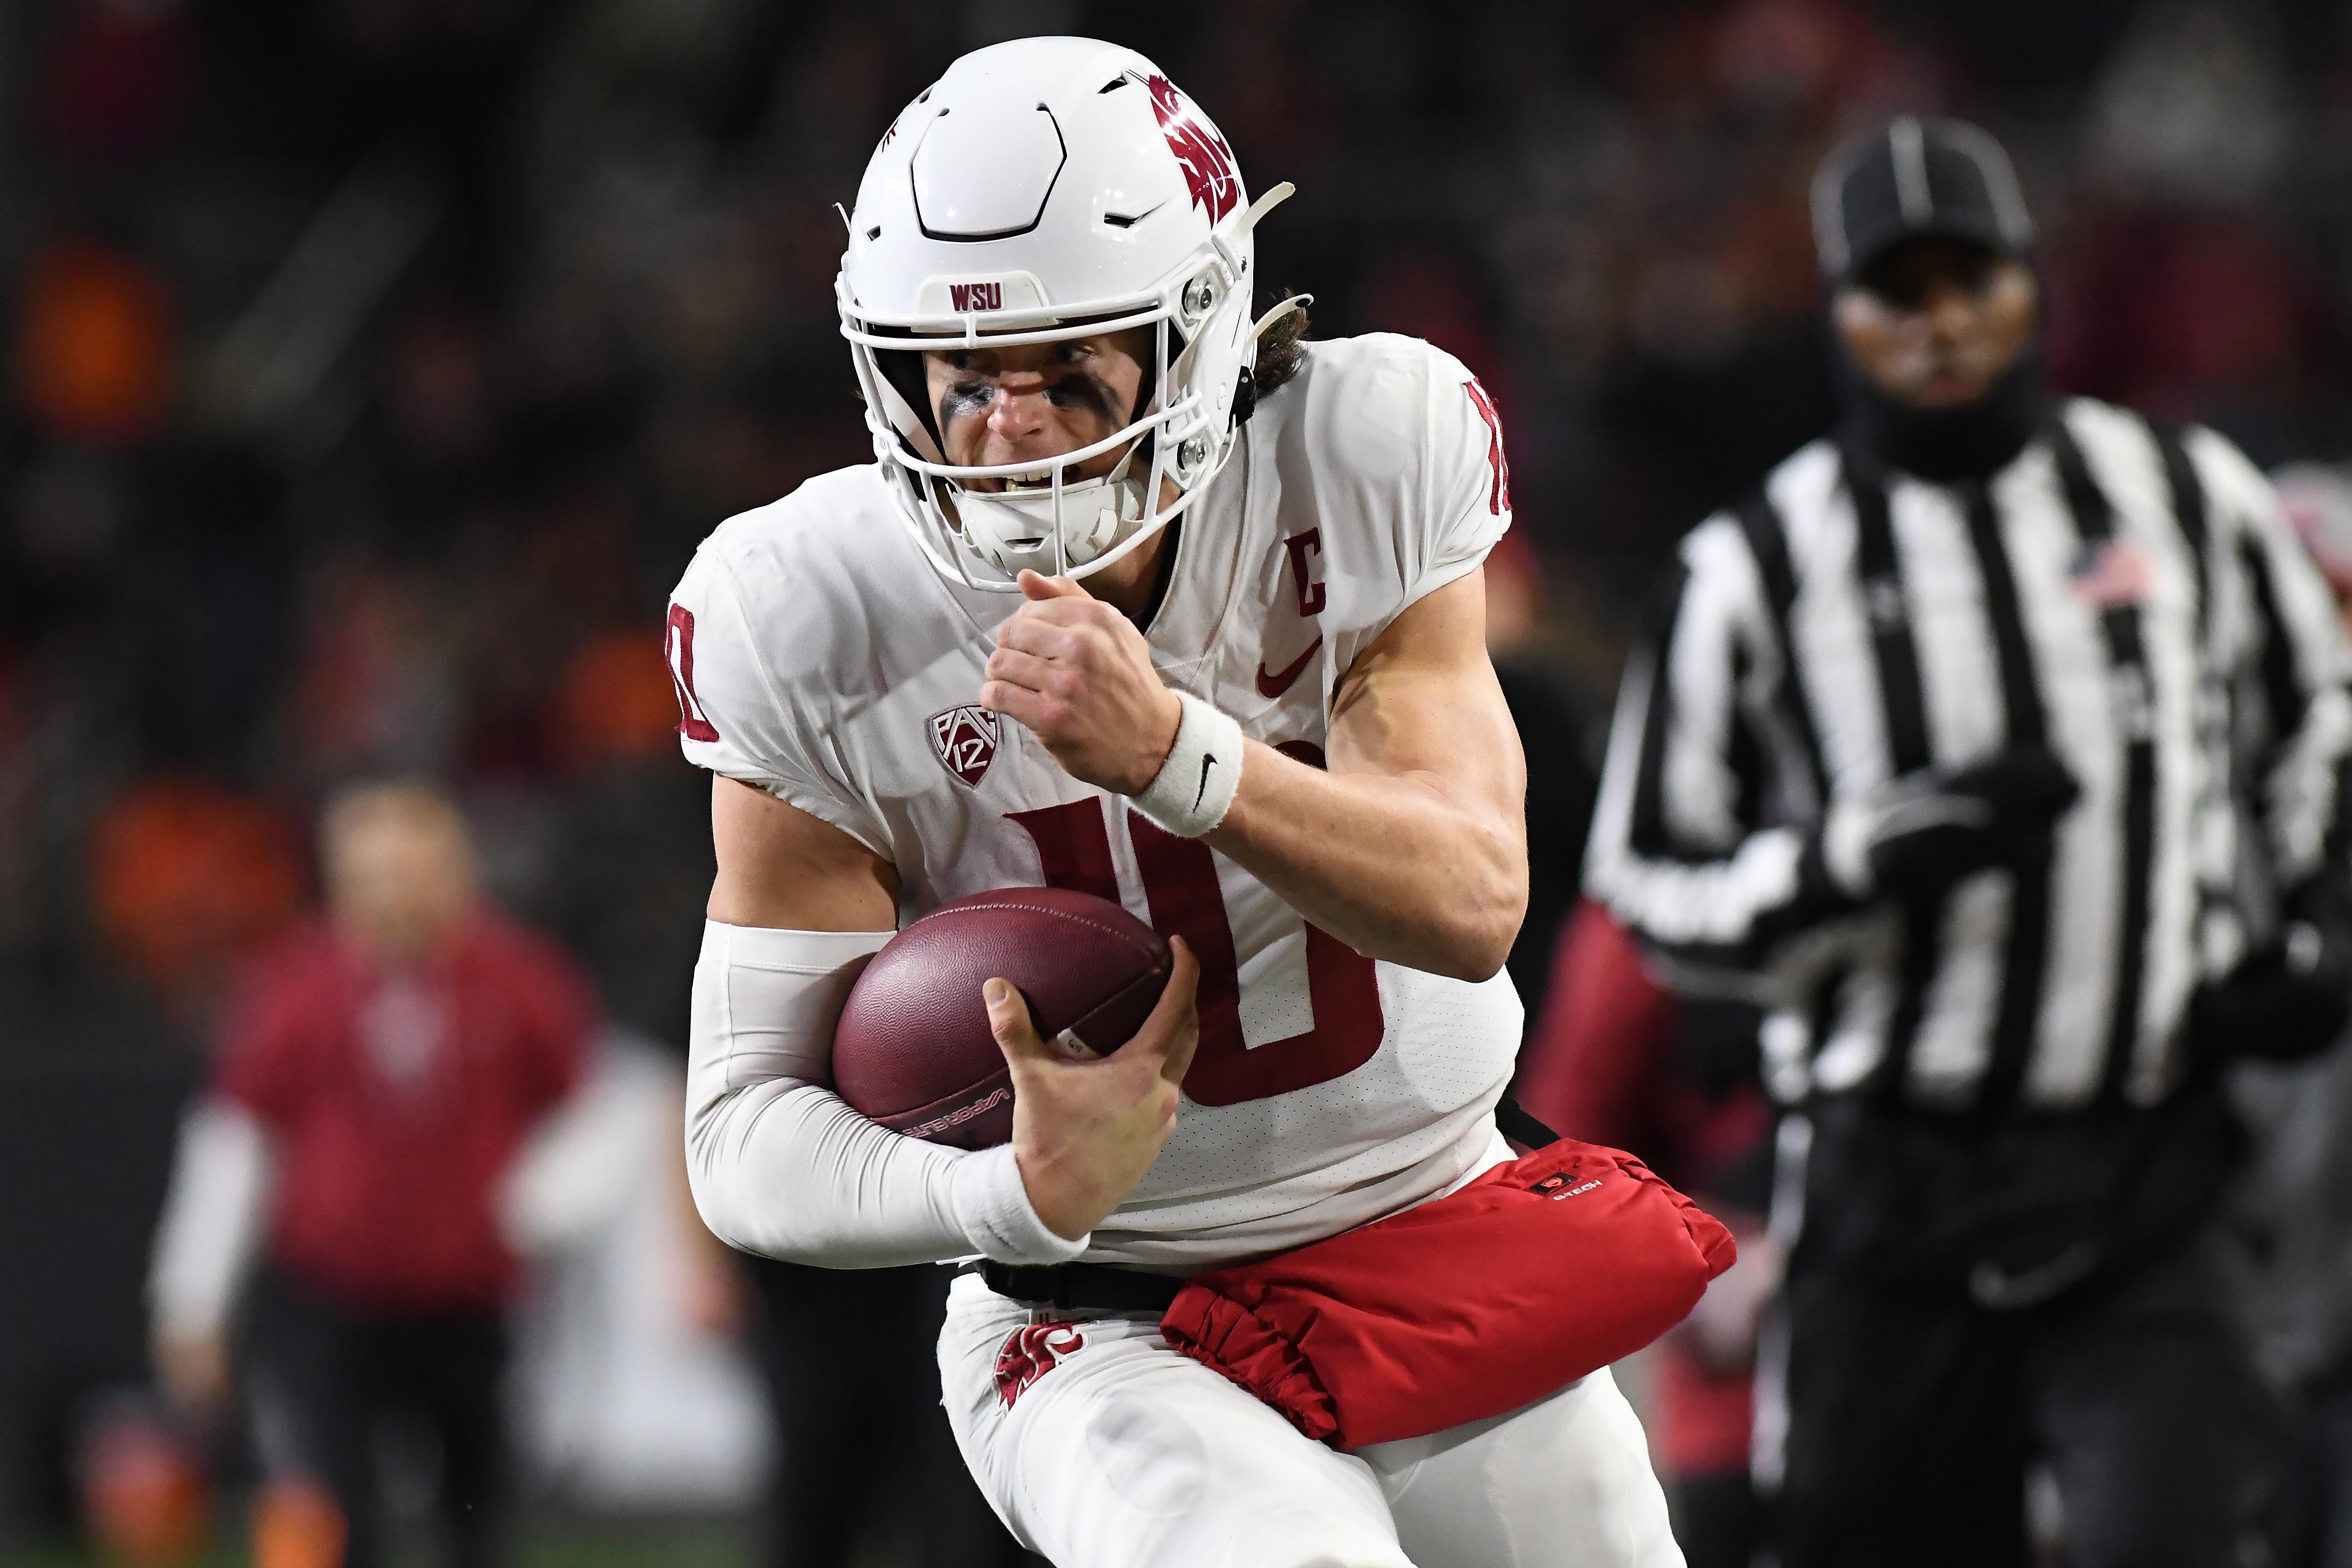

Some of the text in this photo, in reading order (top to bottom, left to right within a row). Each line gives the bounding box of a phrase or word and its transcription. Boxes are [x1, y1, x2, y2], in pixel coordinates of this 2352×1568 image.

[949, 282, 1001, 311] WSU
[1284, 527, 1326, 617] C
[932, 707, 996, 760] PAC
[953, 738, 988, 772] 12
